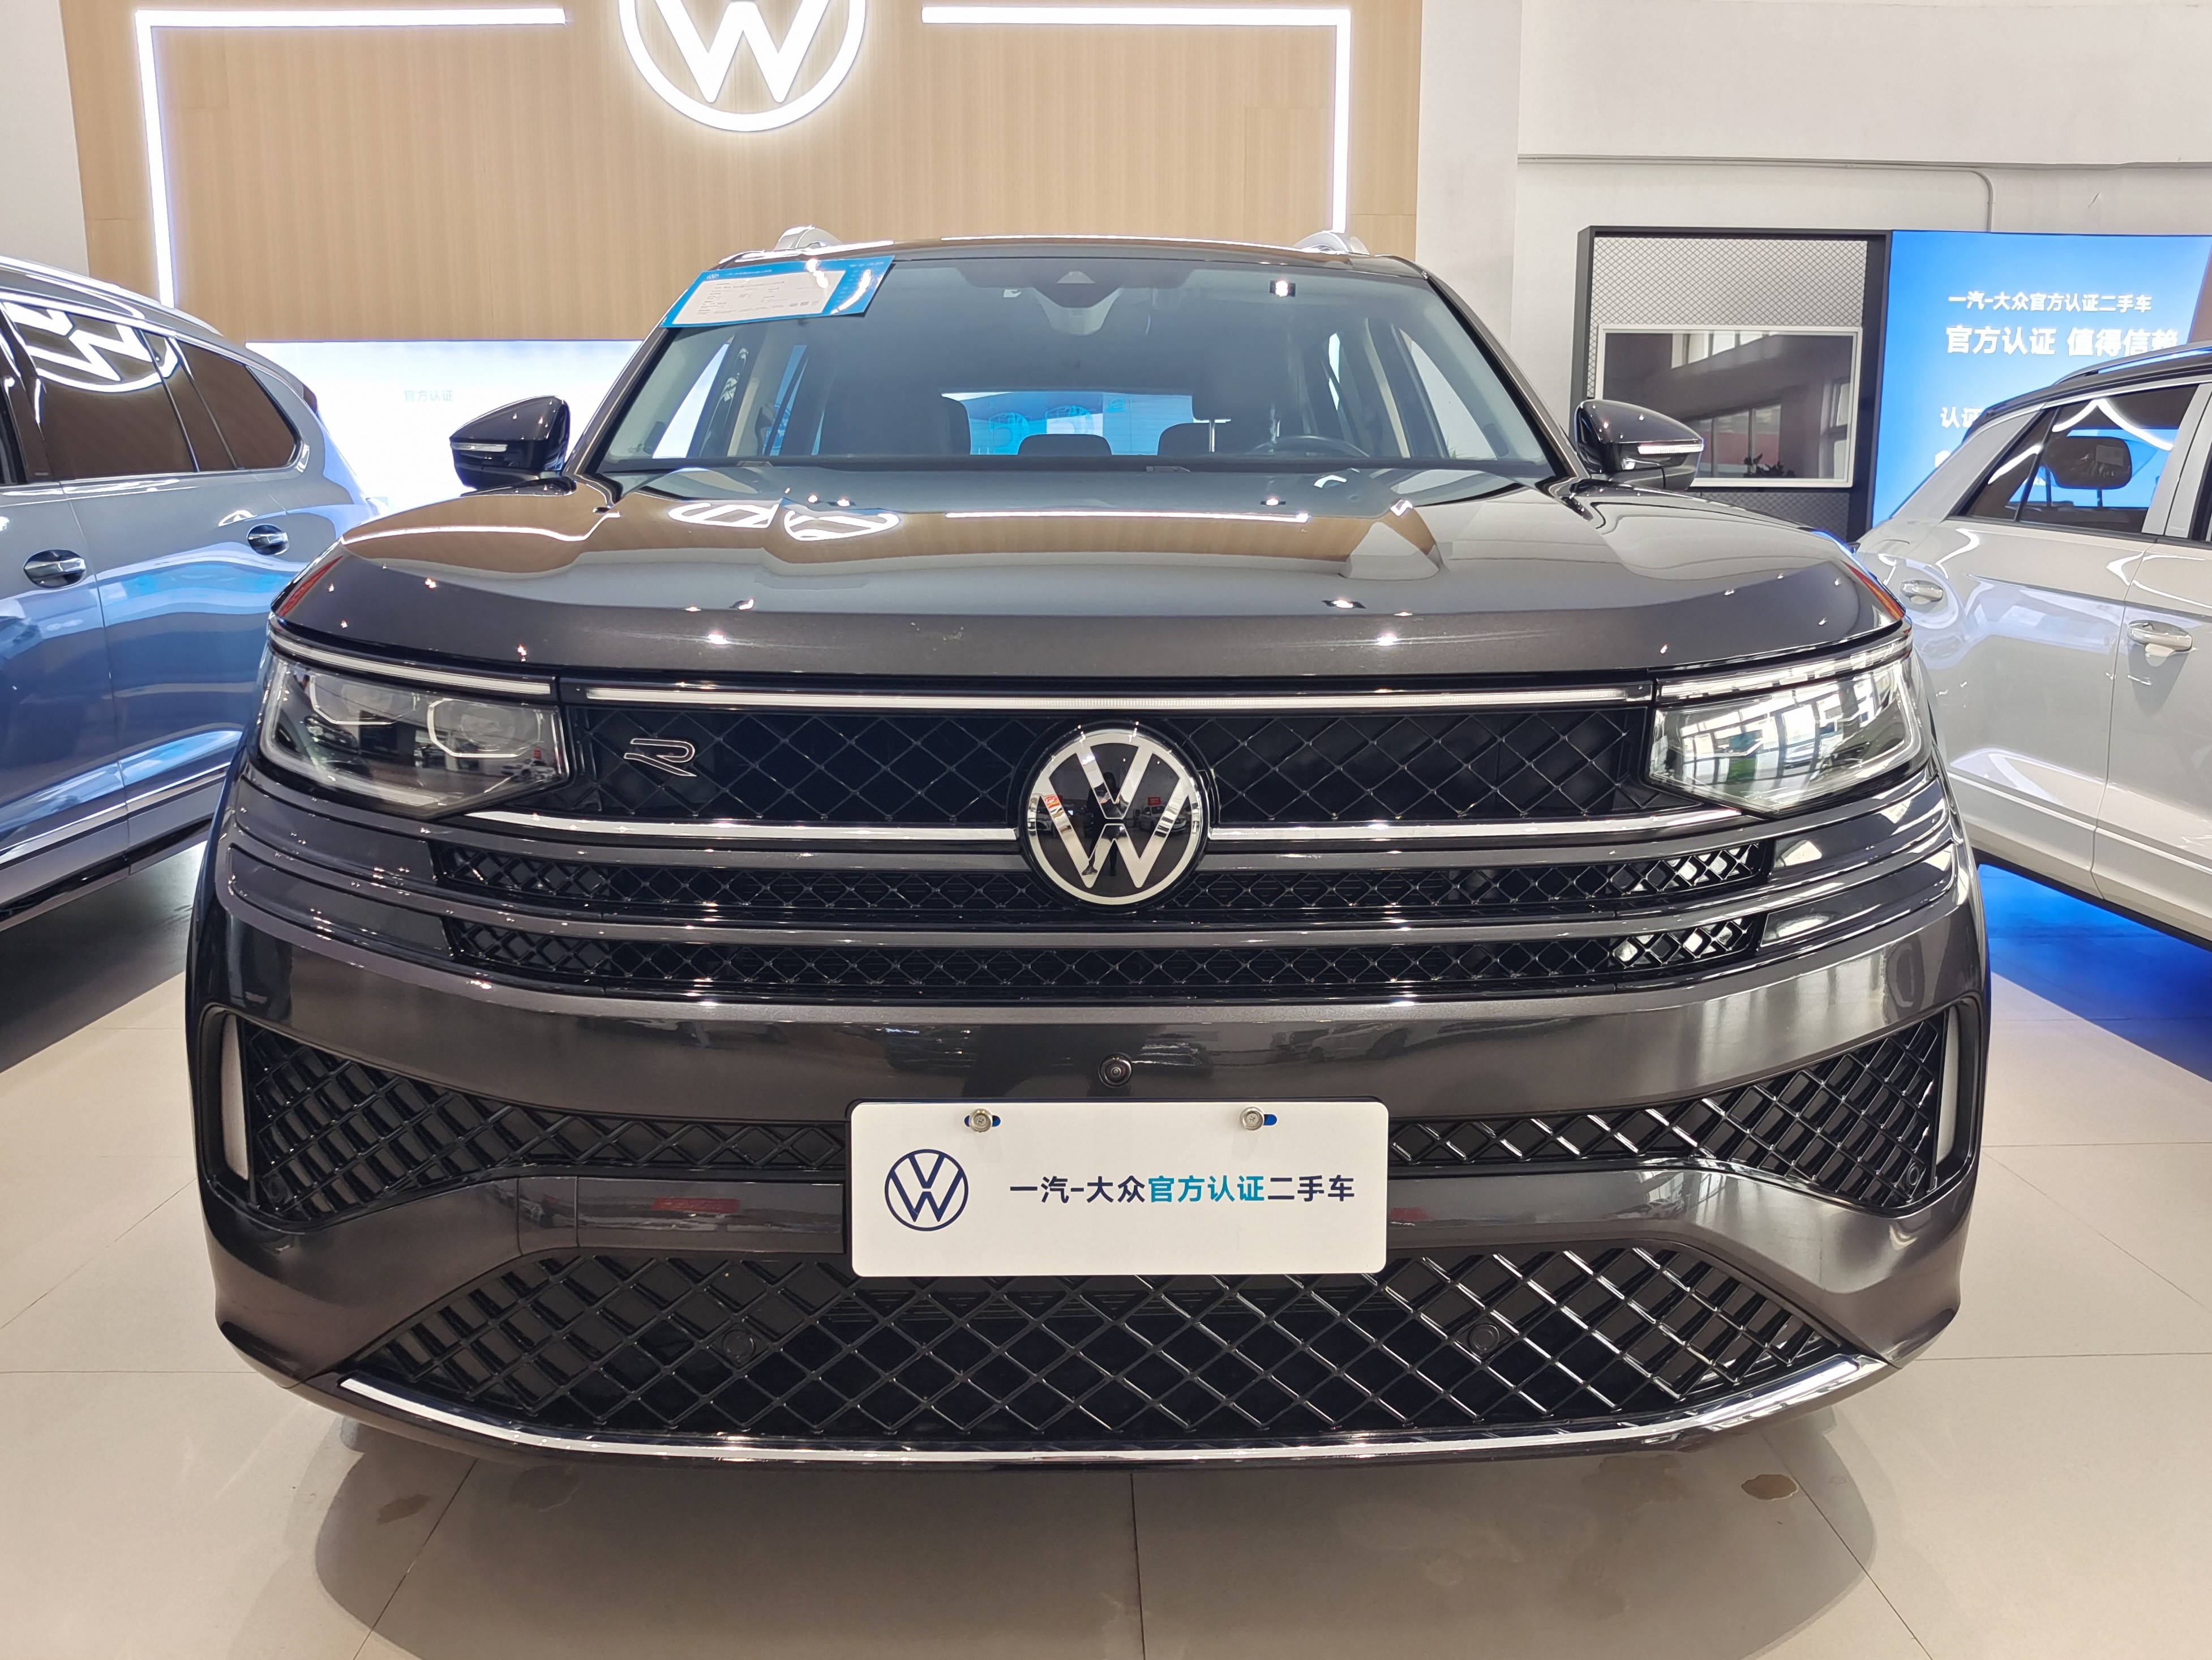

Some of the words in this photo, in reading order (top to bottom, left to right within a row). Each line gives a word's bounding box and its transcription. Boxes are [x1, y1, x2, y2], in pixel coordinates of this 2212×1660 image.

[1948, 291, 2152, 313] 一汽-大众官方认证二手车
[1946, 324, 2057, 355] 官方认证
[404, 390, 454, 403] 官方认证
[623, 738, 697, 777] R
[1010, 1174, 1356, 1204] 一汽-大众官方认证二手车
